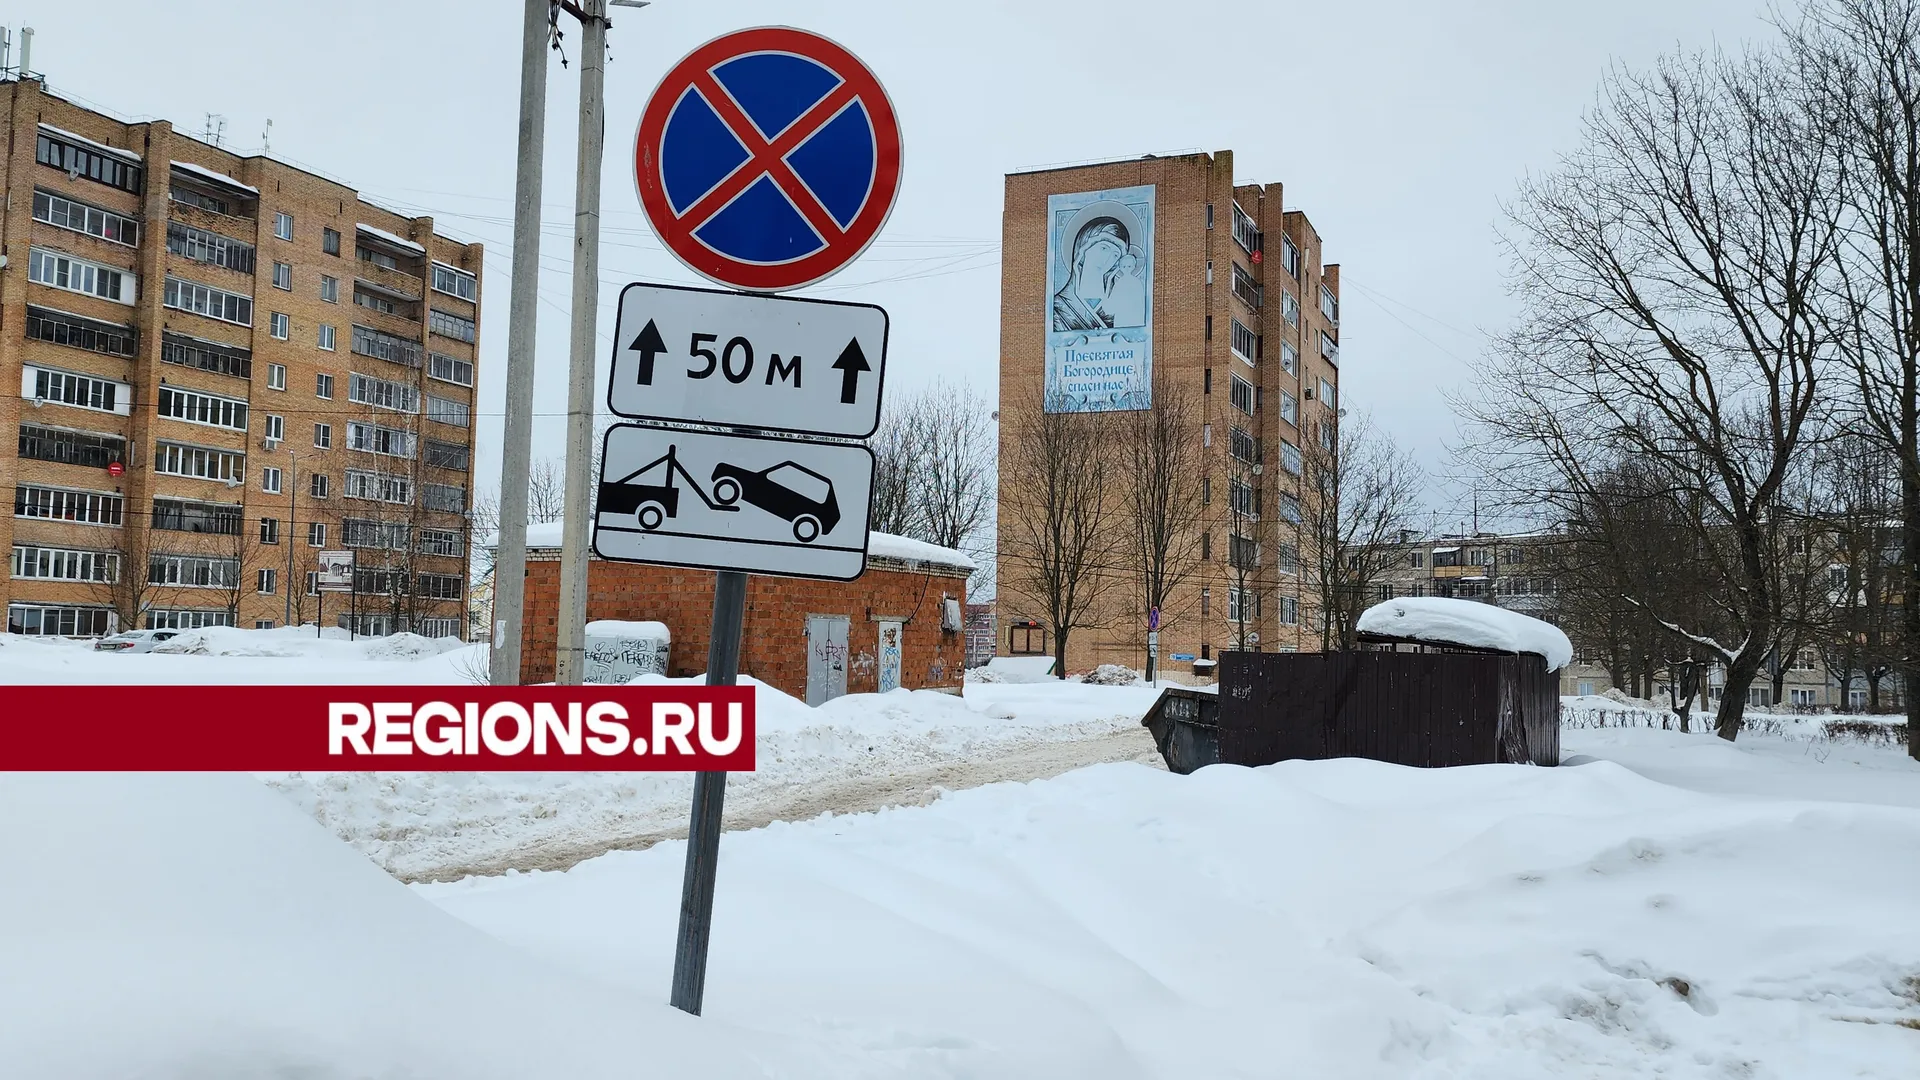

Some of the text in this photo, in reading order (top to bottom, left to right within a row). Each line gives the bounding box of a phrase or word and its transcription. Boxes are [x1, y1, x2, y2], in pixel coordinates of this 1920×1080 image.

[687, 332, 802, 388] 50 м
[1065, 350, 1134, 365] Пресвятая
[1064, 365, 1136, 380] Богородице,
[1068, 382, 1101, 392] спаси
